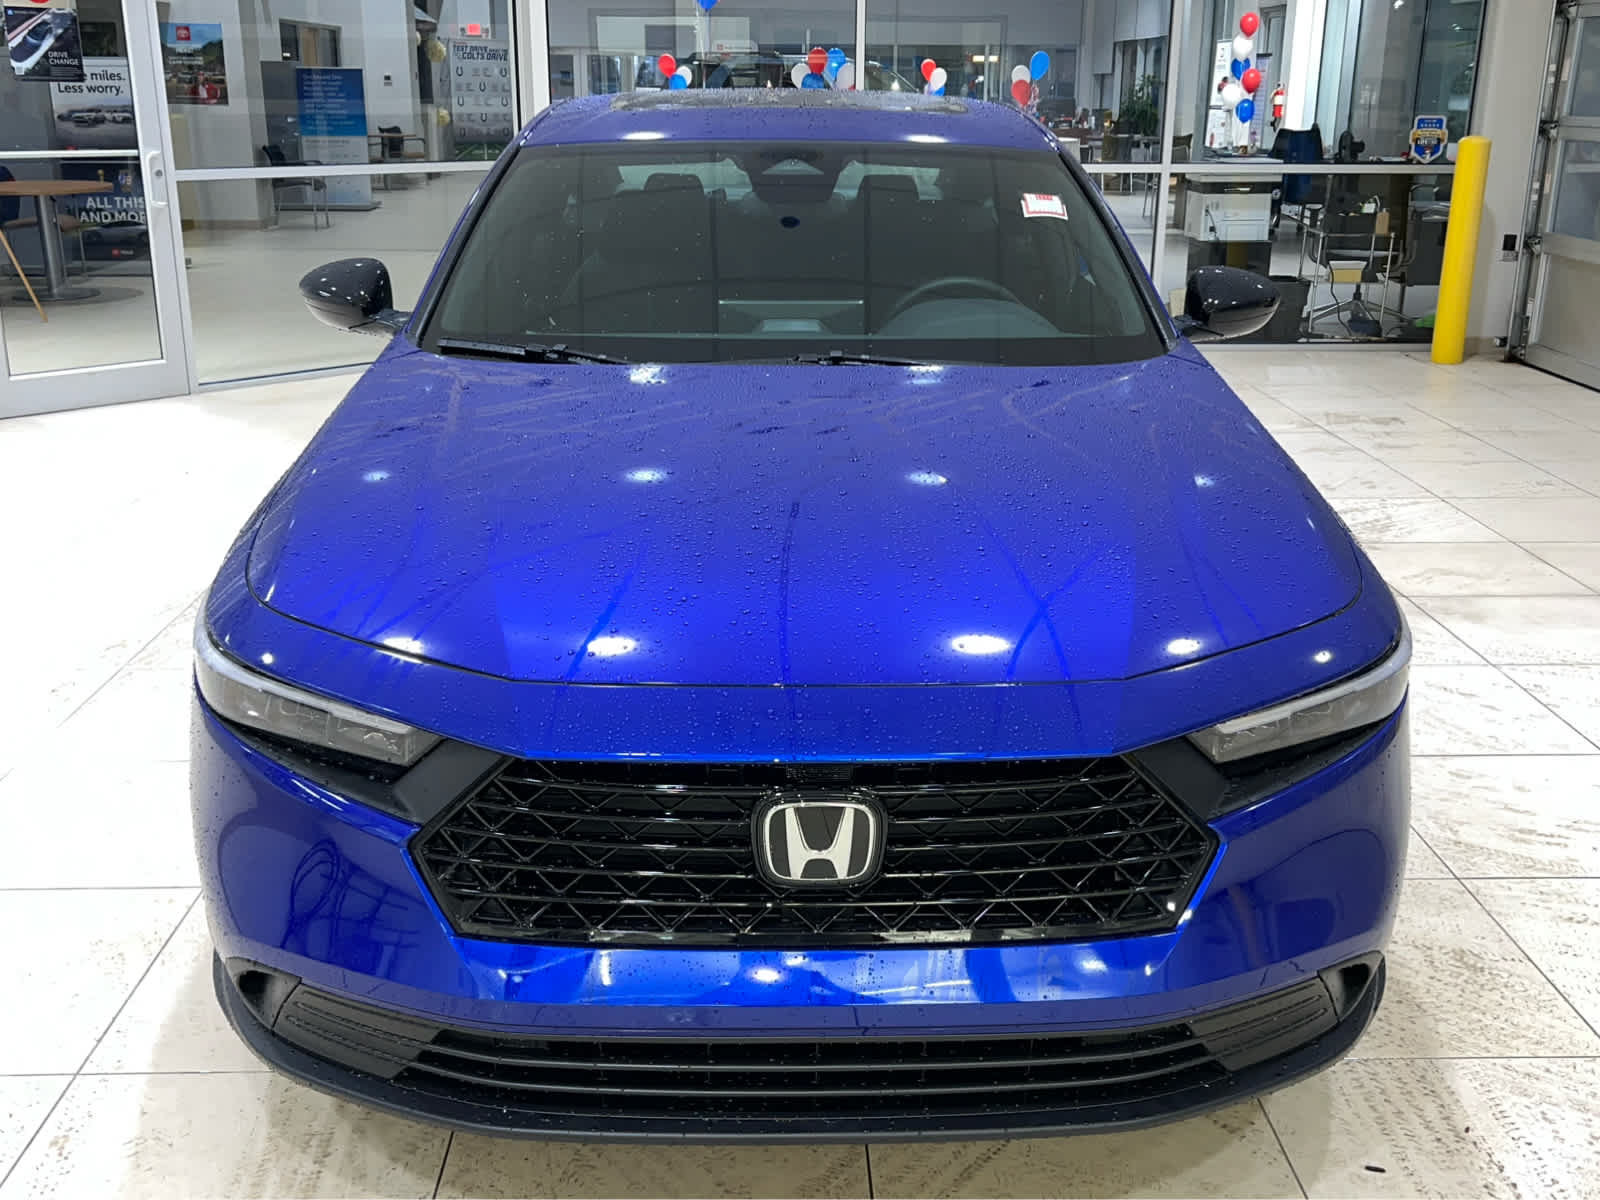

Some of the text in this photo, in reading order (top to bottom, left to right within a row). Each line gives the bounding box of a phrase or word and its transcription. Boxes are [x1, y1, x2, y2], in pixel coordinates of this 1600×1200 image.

[462, 52, 508, 61] COLTS DRIVE
[90, 69, 126, 81] miles.
[58, 83, 124, 96] Less worry.
[86, 196, 112, 208] ALL
[80, 211, 111, 223] AND
